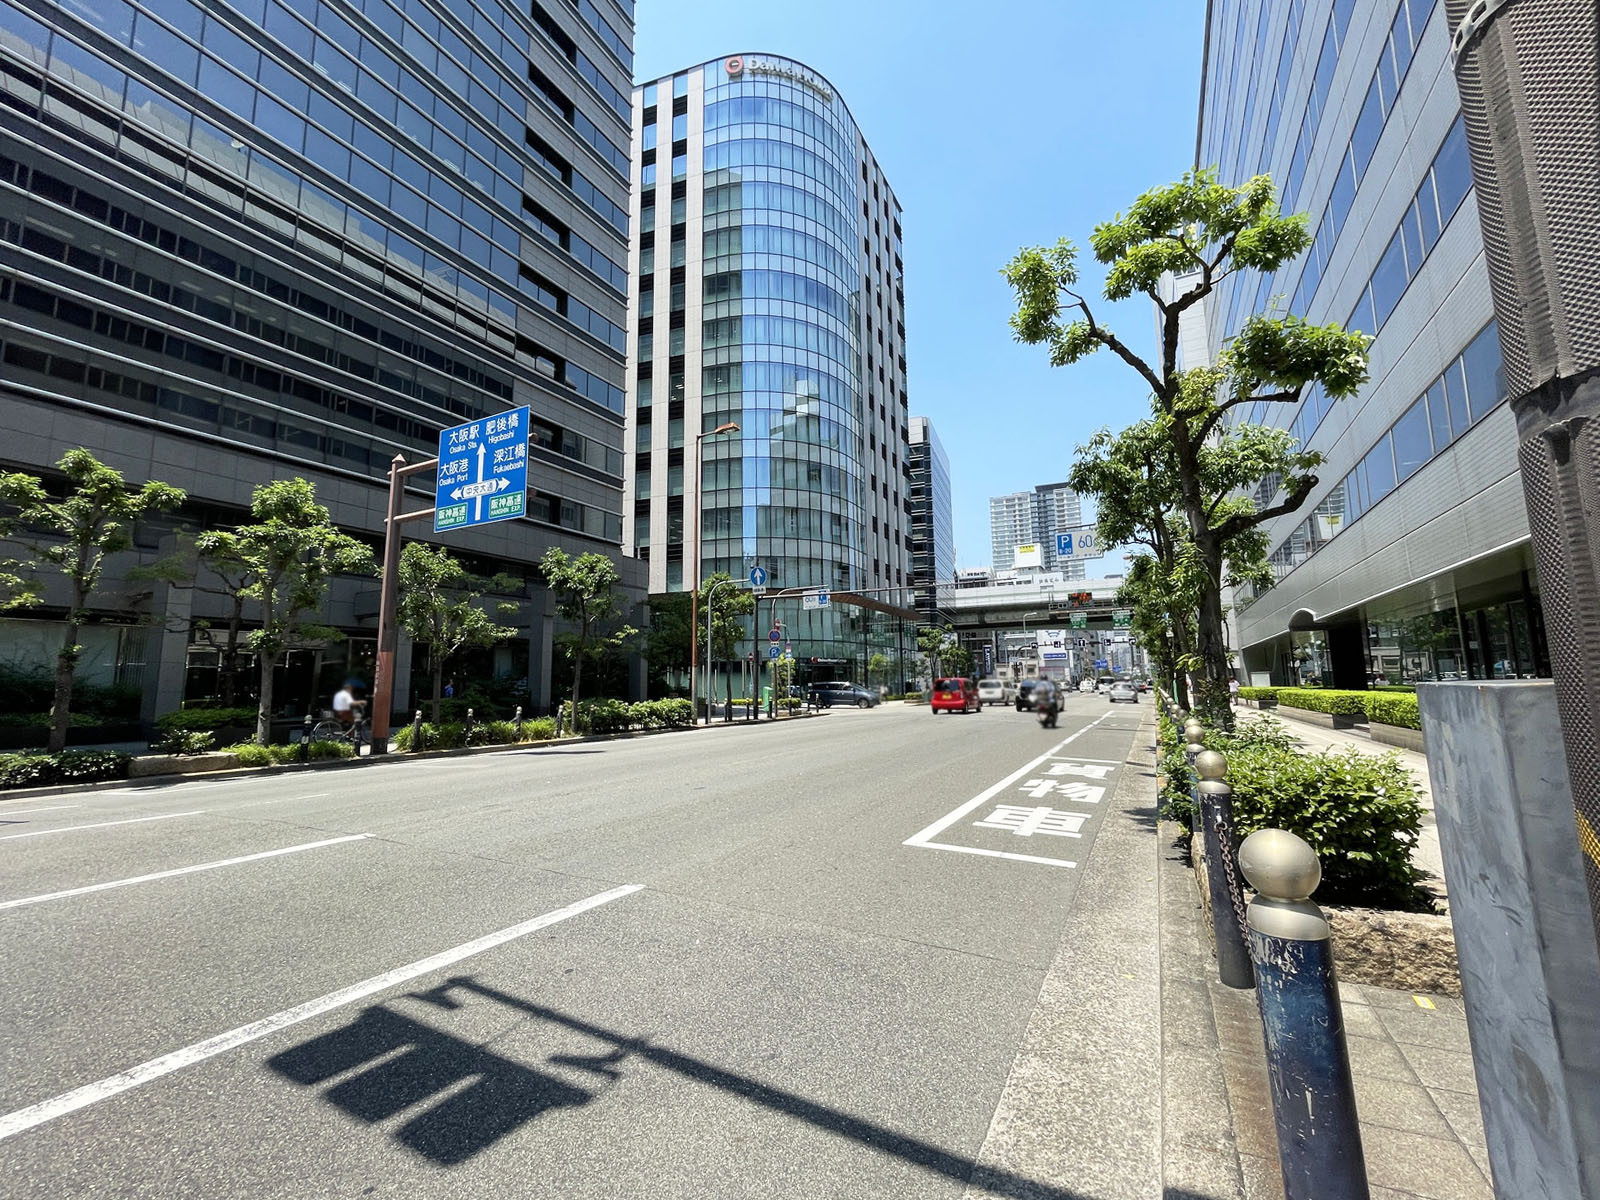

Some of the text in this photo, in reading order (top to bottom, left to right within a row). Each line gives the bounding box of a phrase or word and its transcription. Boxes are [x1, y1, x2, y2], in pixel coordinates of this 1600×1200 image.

[486, 414, 519, 435] 肥後橋
[449, 425, 480, 445] 大阪駅
[489, 430, 514, 444] Higobashi
[449, 445, 466, 454] Osaka
[494, 443, 526, 463] 深江橋
[440, 459, 469, 477] 大阪港
[494, 460, 525, 474] Fukaebashi
[439, 473, 468, 486] Osaka Port
[1061, 536, 1069, 548] P
